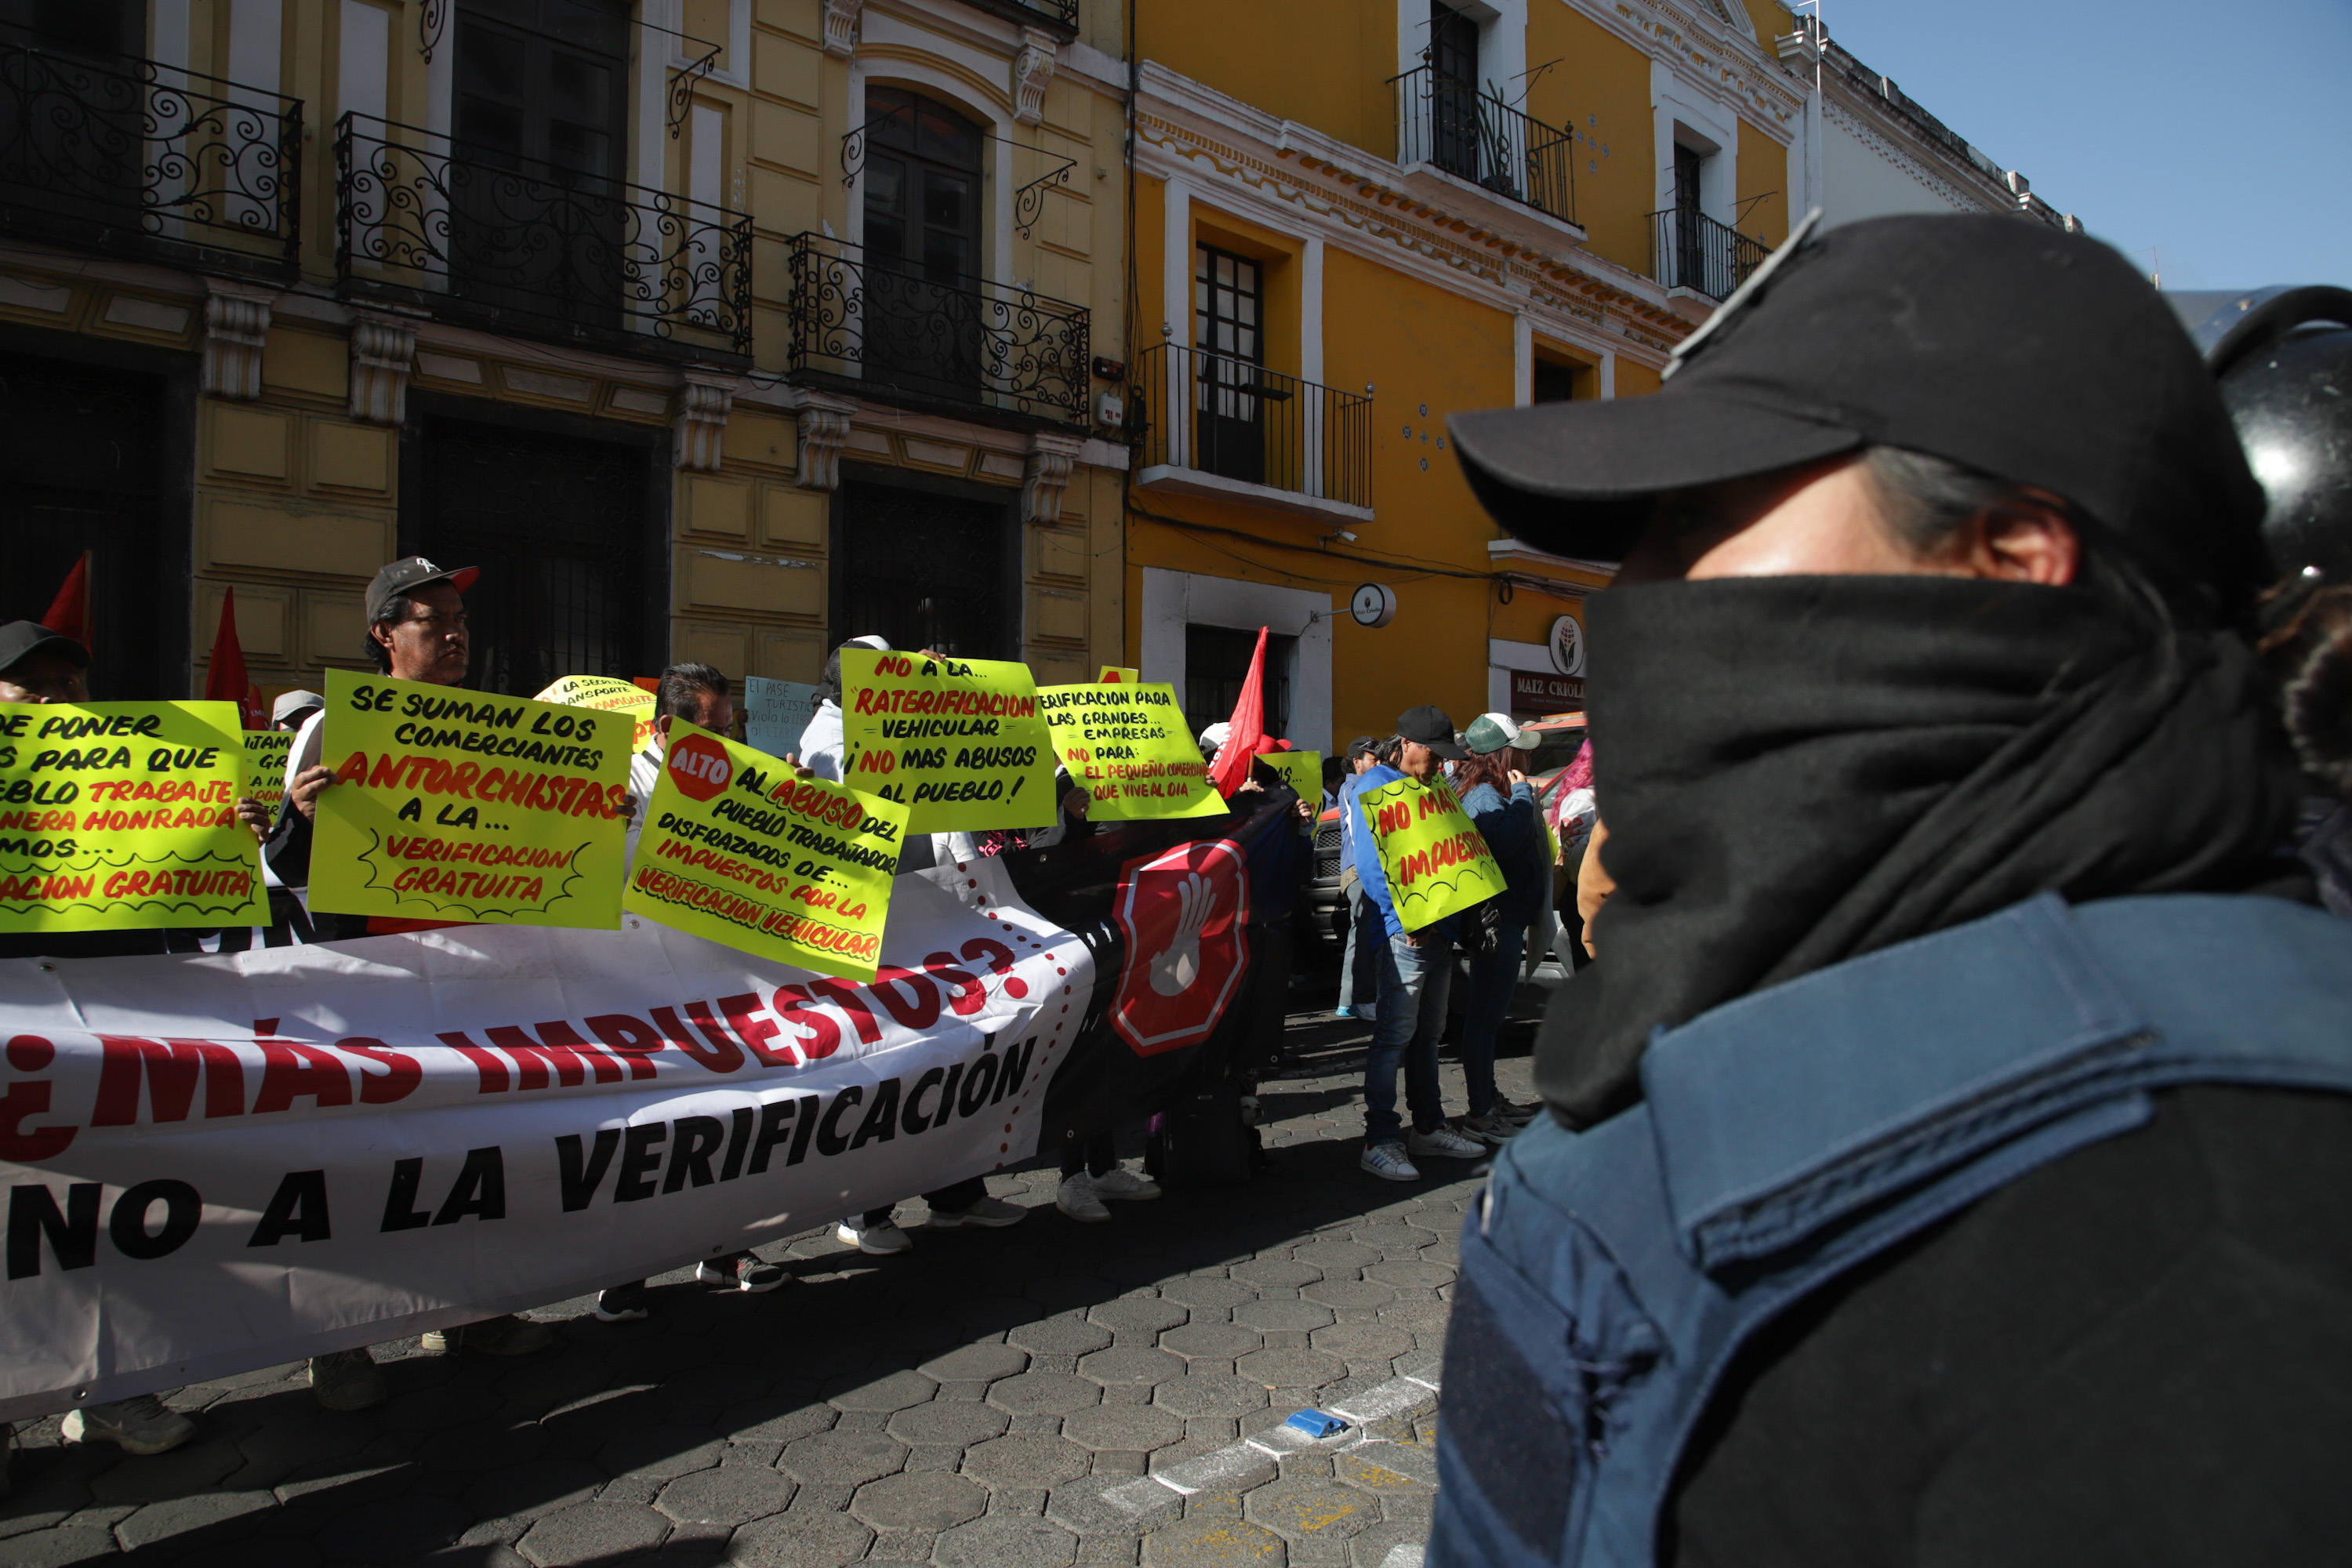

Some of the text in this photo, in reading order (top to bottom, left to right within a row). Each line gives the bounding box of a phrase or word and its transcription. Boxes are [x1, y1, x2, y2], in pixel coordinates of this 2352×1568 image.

[874, 656, 912, 677] NO
[921, 659, 938, 677] A
[563, 681, 580, 693] LA
[766, 682, 790, 697] PASE
[1135, 691, 1171, 706] PARA
[1517, 677, 1544, 695] MAIZ
[350, 685, 397, 712] SE
[401, 694, 525, 729] SUMAN
[531, 711, 597, 742] LOS
[1047, 713, 1076, 726] LAS
[38, 715, 163, 739] PONER
[882, 719, 1000, 738] VEHICULAR
[1083, 727, 1165, 740] EMPRESAS
[31, 748, 131, 771] PARA
[147, 747, 220, 771] QUE
[394, 723, 603, 771] COMERCIANTES
[901, 746, 948, 769] MAS
[954, 746, 1036, 771] ABUSOS
[1067, 747, 1091, 762] NO
[670, 747, 729, 785] ALTO
[1085, 766, 1105, 779] EL
[1107, 760, 1166, 780] PEQUEÑO
[89, 780, 233, 804] TRABAJE
[335, 751, 629, 820] ANTORCHISTAS
[877, 782, 906, 804] AL
[1094, 782, 1189, 800] QUE VIVE AL DIA
[398, 797, 422, 822] A
[735, 767, 898, 842] AL ABUSO DEL
[1379, 788, 1458, 837] NO MAS
[82, 807, 235, 831] HONRADA
[658, 812, 789, 869] DISFRAZADOS
[711, 798, 898, 876] PUEBLO TRABAJADOR
[387, 835, 574, 869] VERIFICACION
[1400, 830, 1490, 887] IMPUESTOS
[103, 869, 252, 899] GRATUITA
[393, 867, 543, 902] GRATUITA
[656, 838, 867, 920] IMPUESTOS POR LA
[637, 866, 879, 959] VERIFICACION VEHICULAR
[435, 937, 1028, 1094] IMPUESTOS?
[7, 1033, 1039, 1280] NO A LA VERIFICACIÓN
